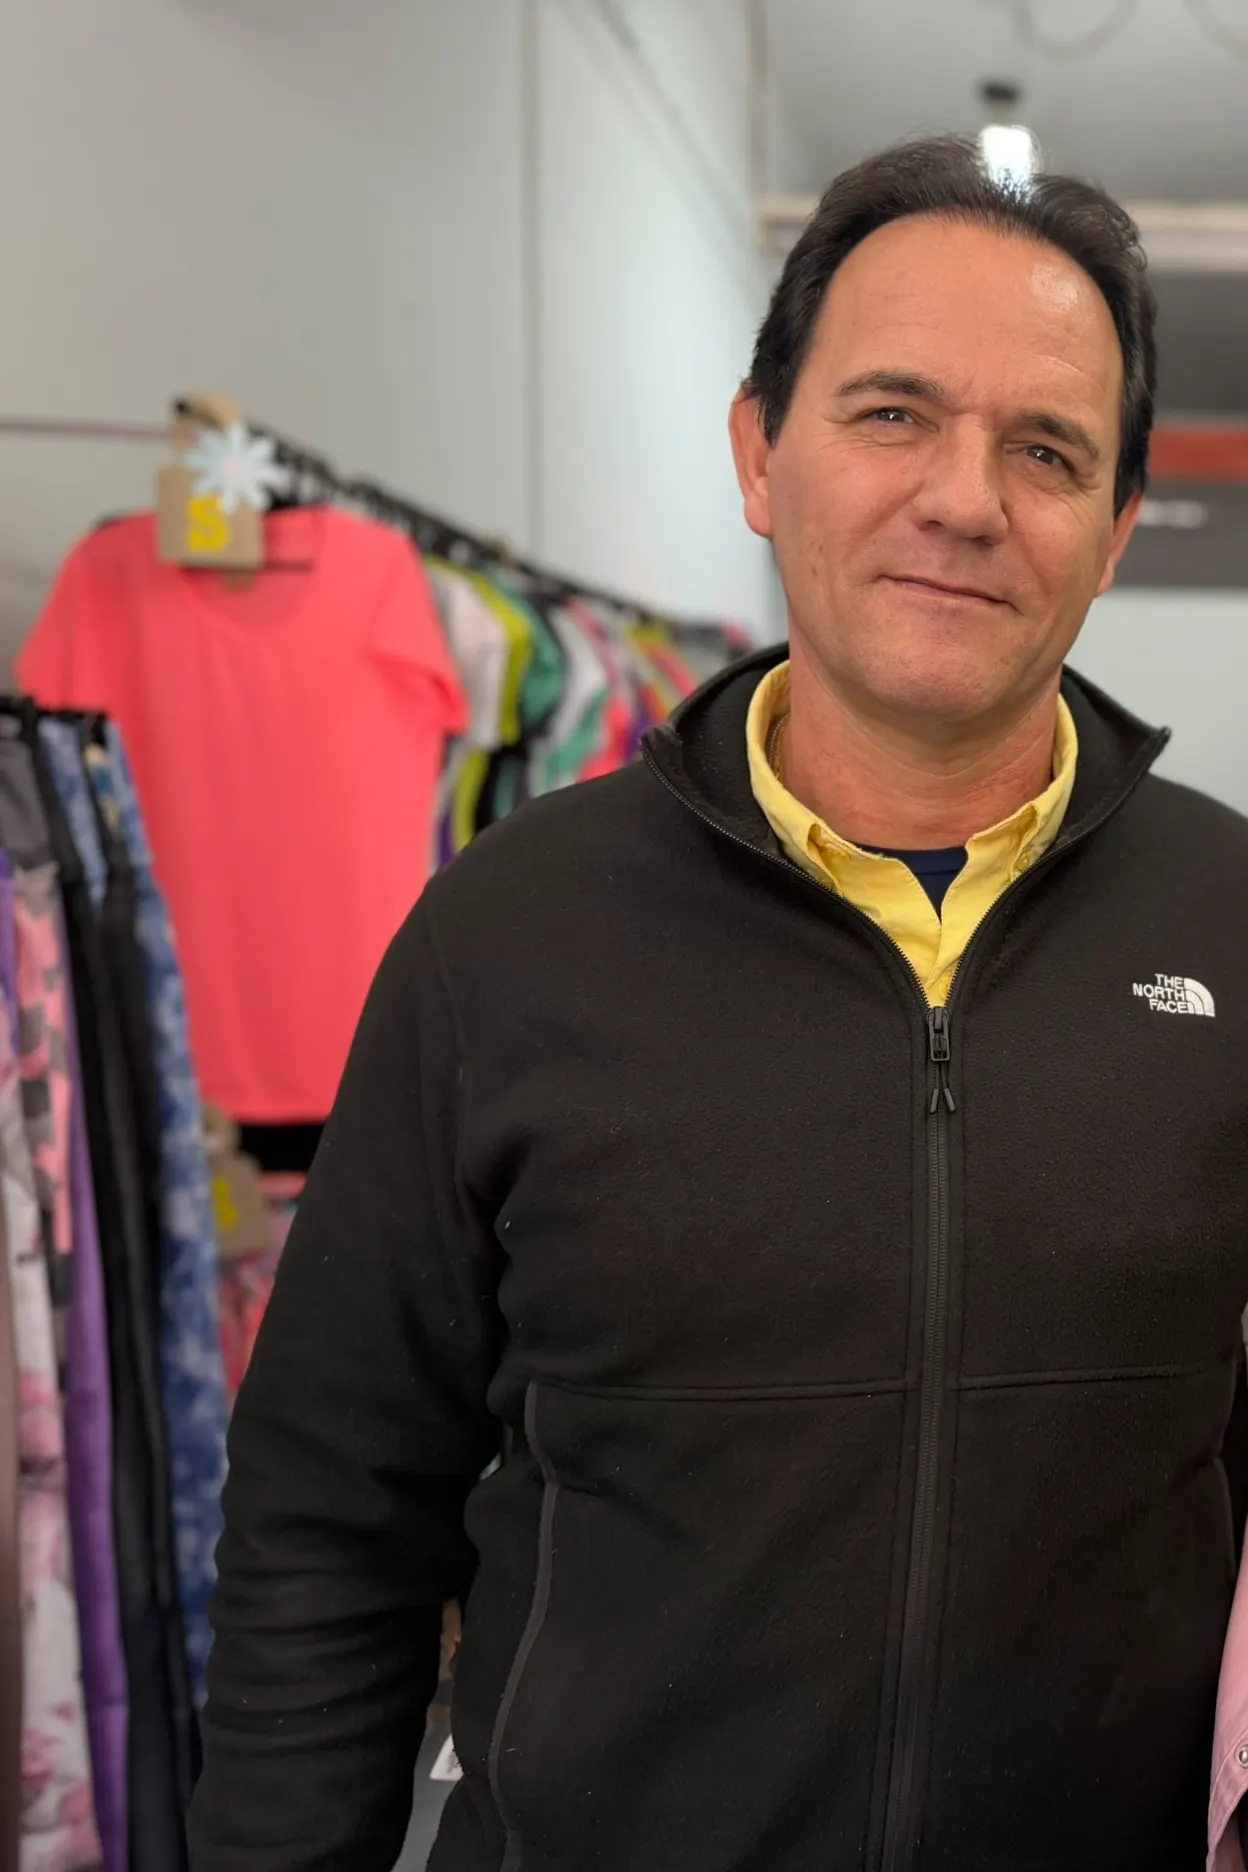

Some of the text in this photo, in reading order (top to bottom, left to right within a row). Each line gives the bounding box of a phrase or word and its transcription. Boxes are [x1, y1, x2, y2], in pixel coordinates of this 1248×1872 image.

[188, 494, 228, 553] S
[1154, 973, 1184, 989] THE
[1132, 982, 1185, 1001] NORTH
[1149, 998, 1188, 1014] FACE
